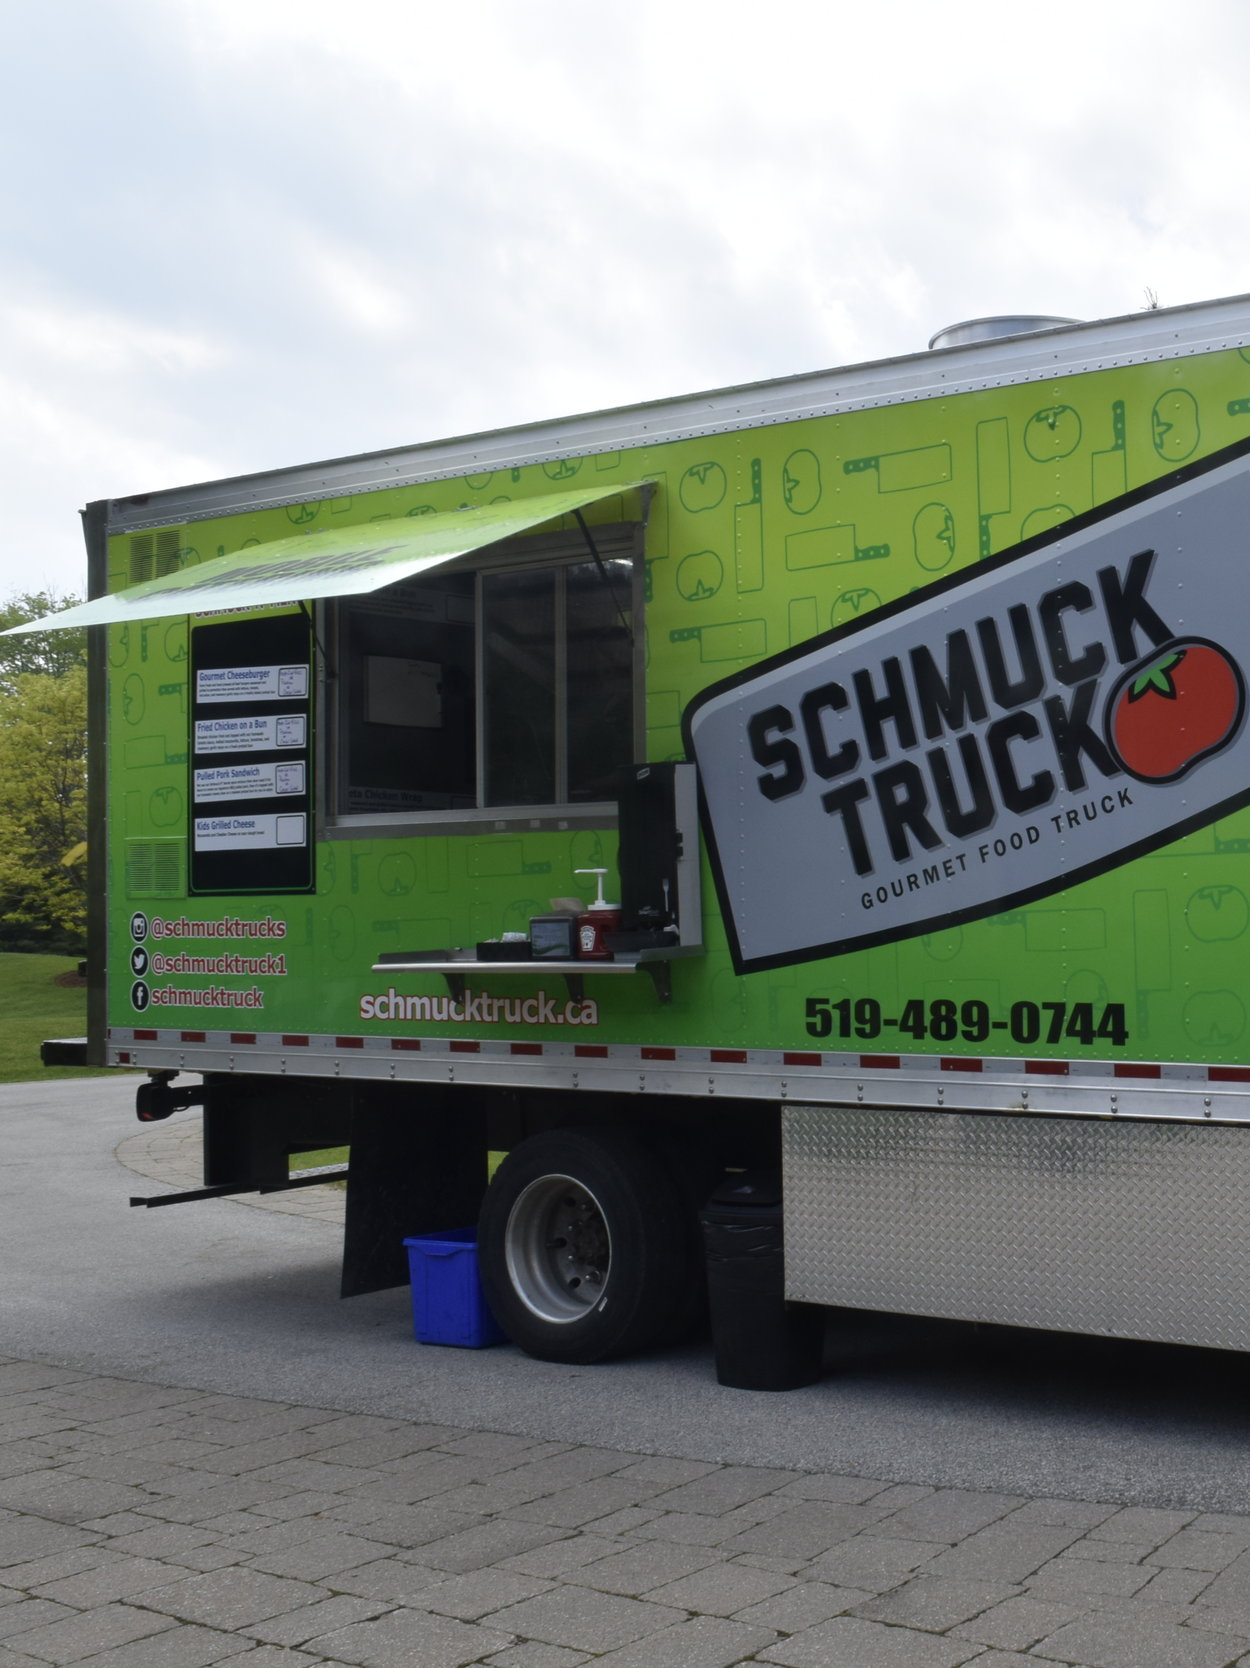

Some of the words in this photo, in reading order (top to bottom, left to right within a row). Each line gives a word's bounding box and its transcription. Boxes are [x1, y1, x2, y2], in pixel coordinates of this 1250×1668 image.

[199, 671, 226, 681] Gourmet
[227, 669, 270, 681] Cheeseburger
[746, 548, 1177, 801] SCHMUCK
[197, 723, 213, 732] Fried
[214, 721, 238, 731] Chicken
[239, 722, 247, 730] on
[255, 719, 267, 729] Bun
[196, 771, 215, 781] Pulled
[216, 769, 230, 779] Pork
[231, 767, 260, 778] Sandwich
[821, 677, 1124, 878] TRUCK
[197, 820, 210, 830] Kids
[211, 820, 231, 830] Grilled
[233, 819, 255, 829] Cheese
[860, 853, 970, 911] GOURMET
[978, 824, 1042, 863] FOOD
[1050, 787, 1135, 835] TRUCK
[151, 916, 286, 940] @schmucktrucks
[152, 952, 287, 976] @schmucktruck1
[152, 984, 264, 1008] schmucktruck
[360, 987, 598, 1025] schmucktruck.ca
[804, 997, 1129, 1046] 519-489-0744
